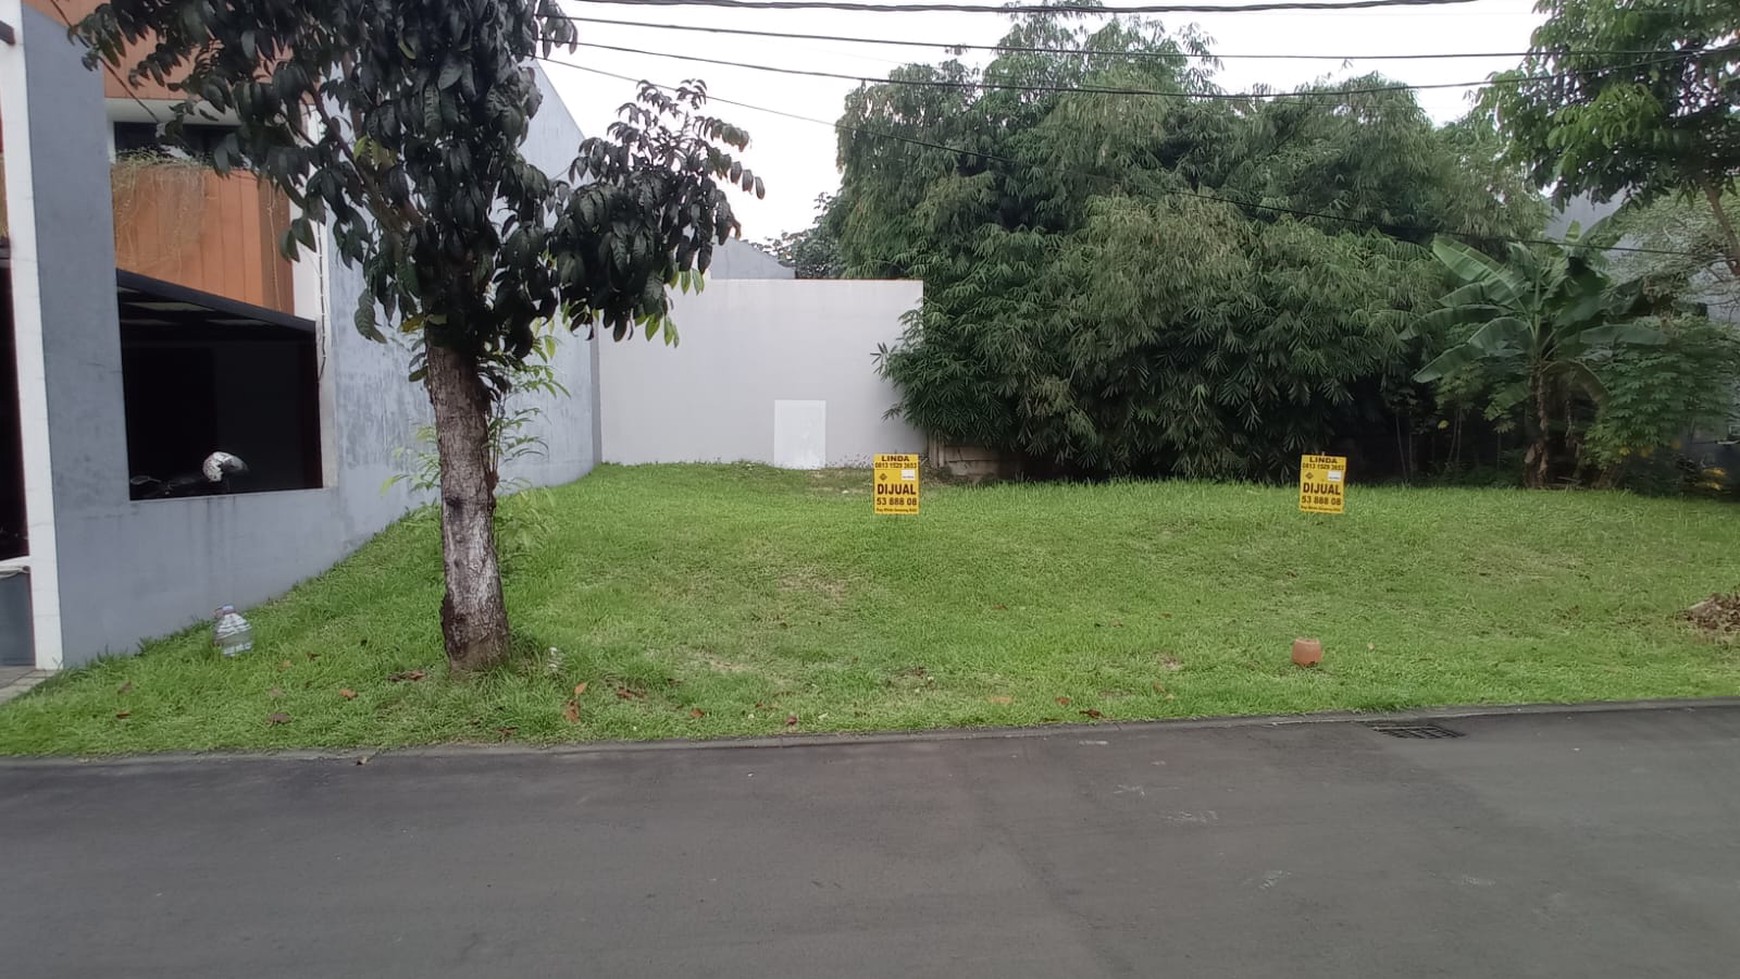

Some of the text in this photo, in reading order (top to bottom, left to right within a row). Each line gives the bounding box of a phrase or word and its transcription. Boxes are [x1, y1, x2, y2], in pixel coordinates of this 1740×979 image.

[877, 484, 916, 495] DIJUAL
[1303, 482, 1341, 495] DIJUAL
[876, 497, 917, 505] 53 888 08
[1301, 495, 1341, 505] 53 888 08
